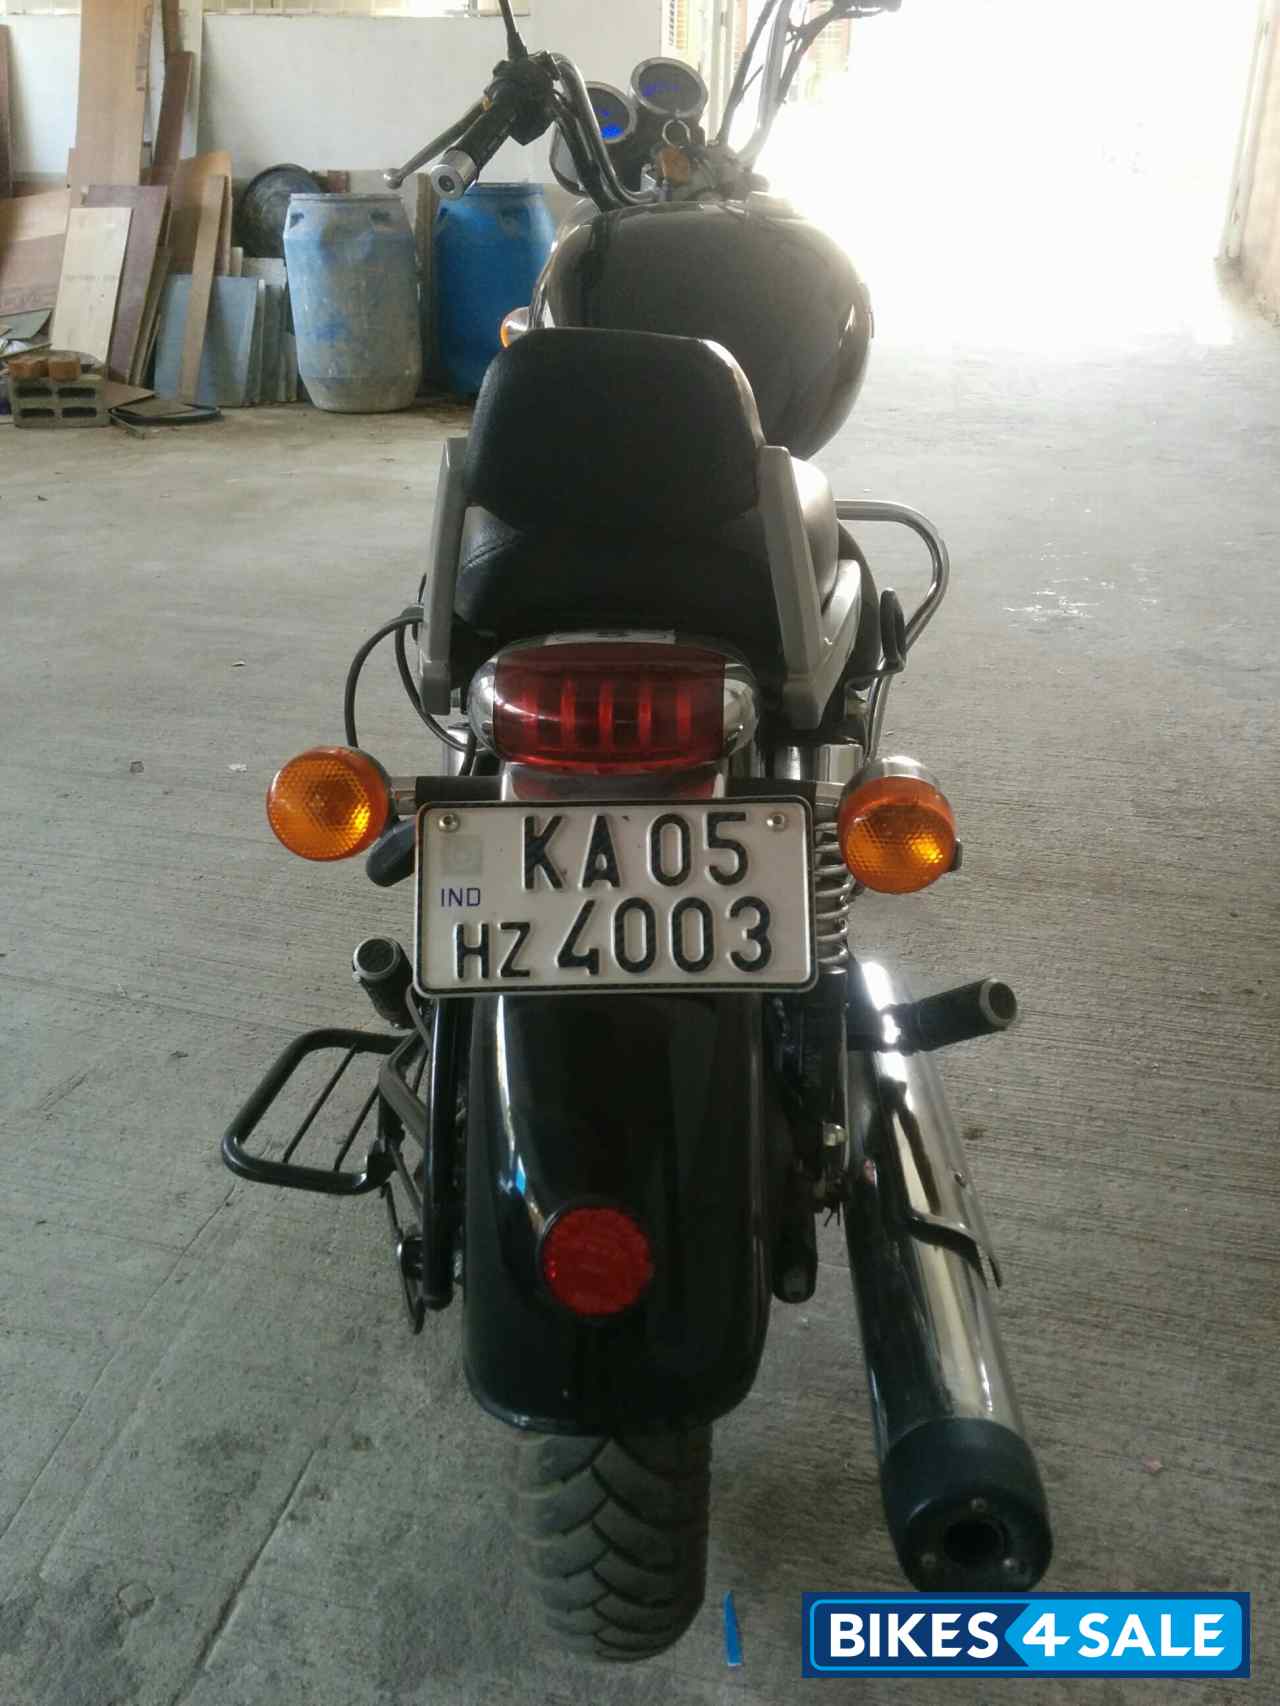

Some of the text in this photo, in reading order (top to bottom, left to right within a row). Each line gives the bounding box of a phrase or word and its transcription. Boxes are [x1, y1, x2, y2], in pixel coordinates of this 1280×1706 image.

[524, 812, 749, 890] KA 05
[440, 888, 481, 906] IND
[455, 896, 772, 978] HZ 4003
